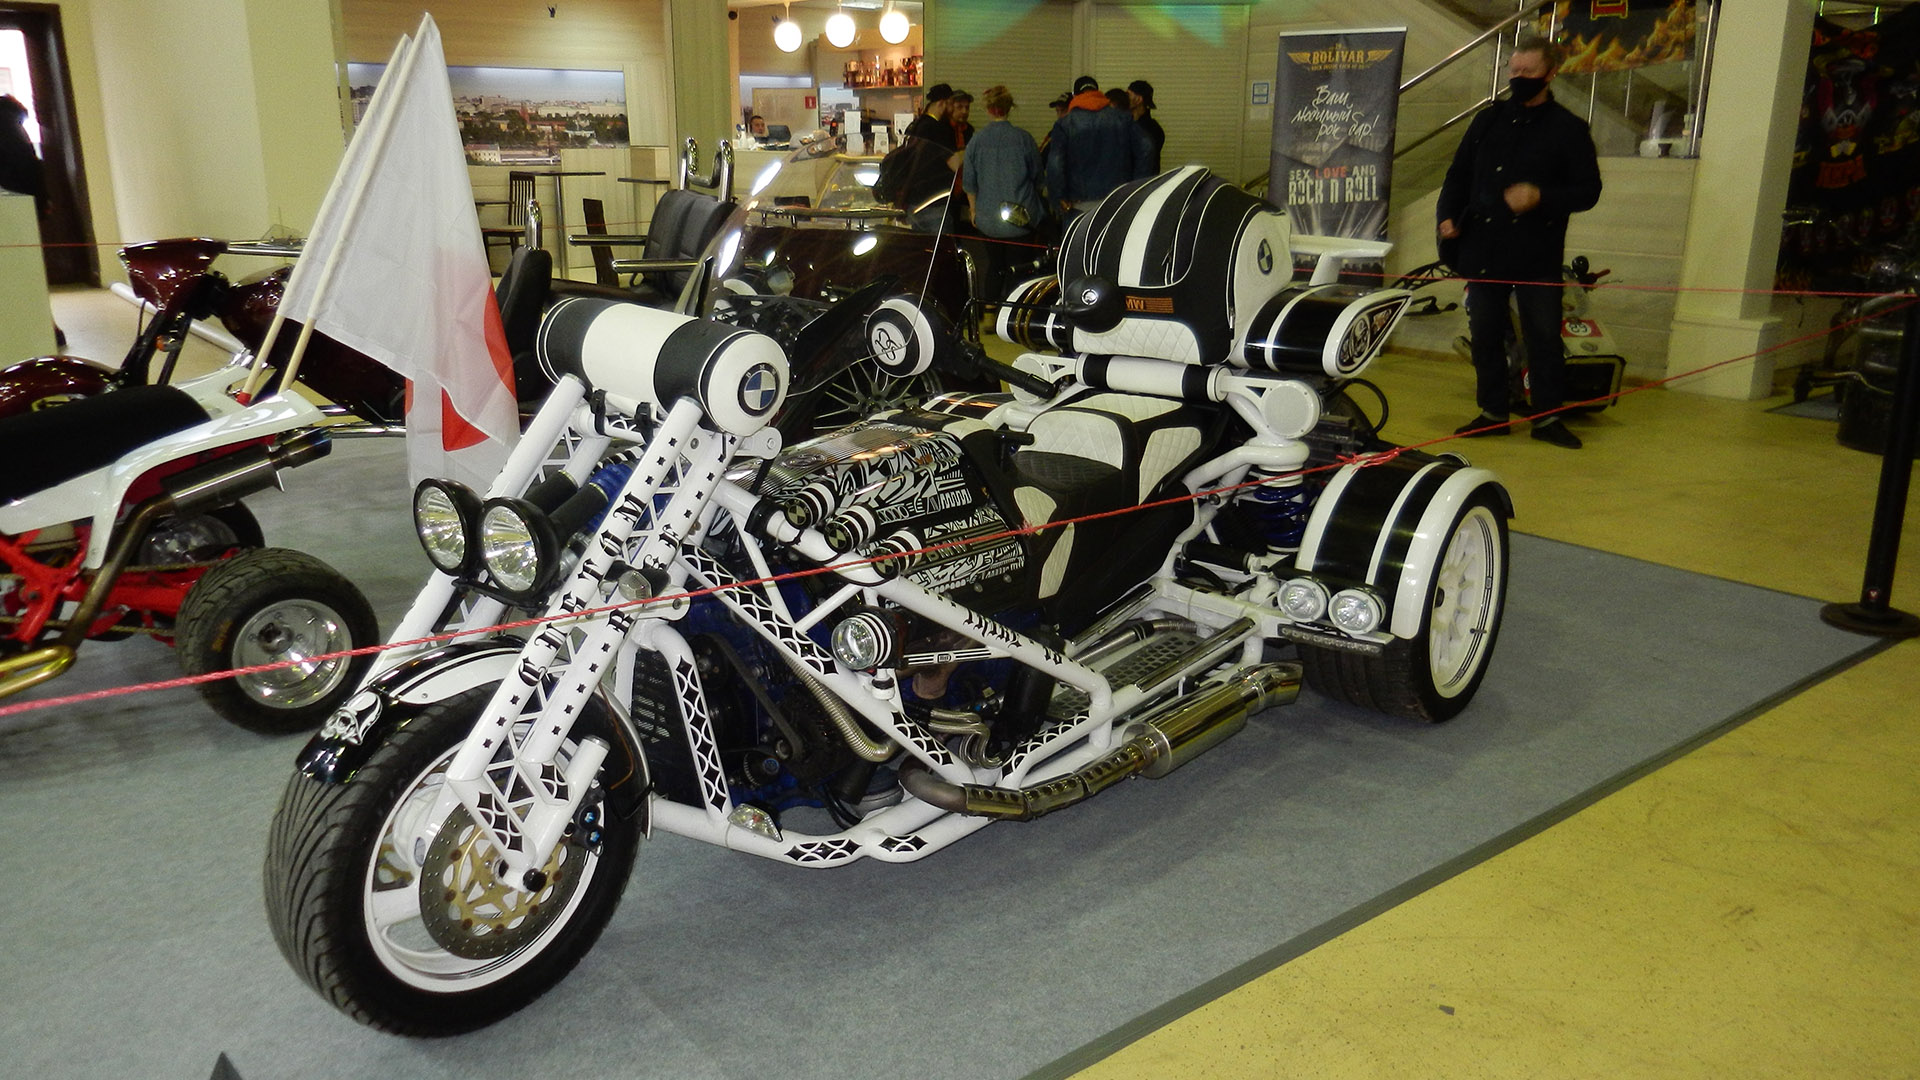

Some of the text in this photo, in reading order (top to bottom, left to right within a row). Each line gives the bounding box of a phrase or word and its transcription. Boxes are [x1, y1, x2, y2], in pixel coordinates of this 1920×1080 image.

[1312, 50, 1365, 65] BOLIVAR
[1315, 85, 1349, 106] Ваш
[1291, 99, 1353, 124] любимый
[1315, 111, 1381, 142] рок бар!
[1289, 164, 1377, 181] SEX LOVE AND
[1288, 179, 1324, 206] ROCK
[1345, 177, 1379, 203] ROLL
[745, 364, 777, 378] BMW
[518, 491, 649, 687] CUSTOM
